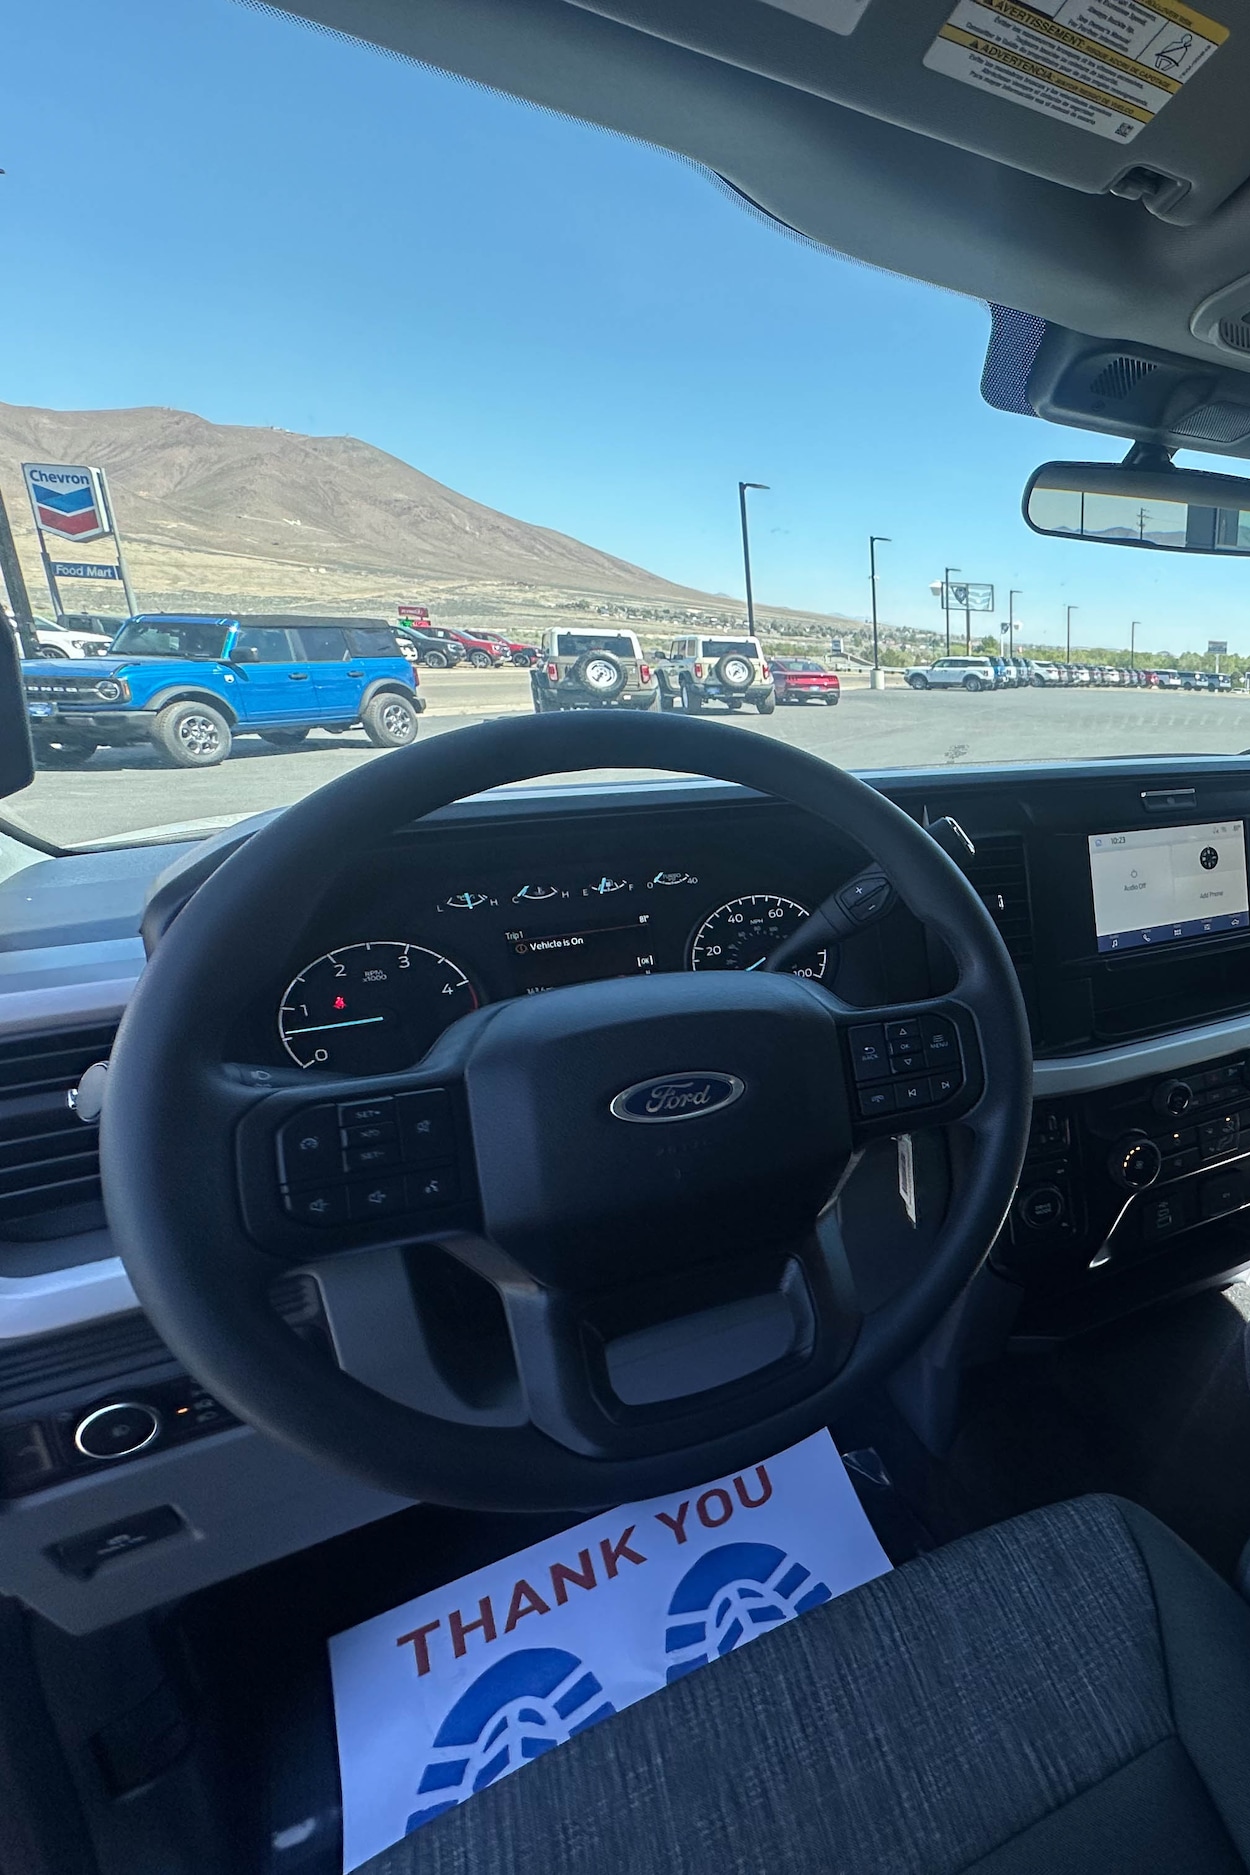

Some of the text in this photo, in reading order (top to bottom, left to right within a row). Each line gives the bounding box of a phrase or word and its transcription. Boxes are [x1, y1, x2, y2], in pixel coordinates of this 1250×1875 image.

[29, 470, 90, 485] Chevron
[55, 565, 113, 578] Food Mart
[1111, 836, 1126, 845] 10:23
[727, 913, 743, 924] 40
[768, 908, 784, 919] 60
[530, 937, 584, 951] Vehicle is On
[706, 945, 722, 956] 20
[398, 954, 411, 969] 3
[334, 963, 347, 978] 2
[441, 982, 455, 996] 4
[645, 1081, 712, 1113] Ford
[396, 1465, 773, 1677] THANK YOU
